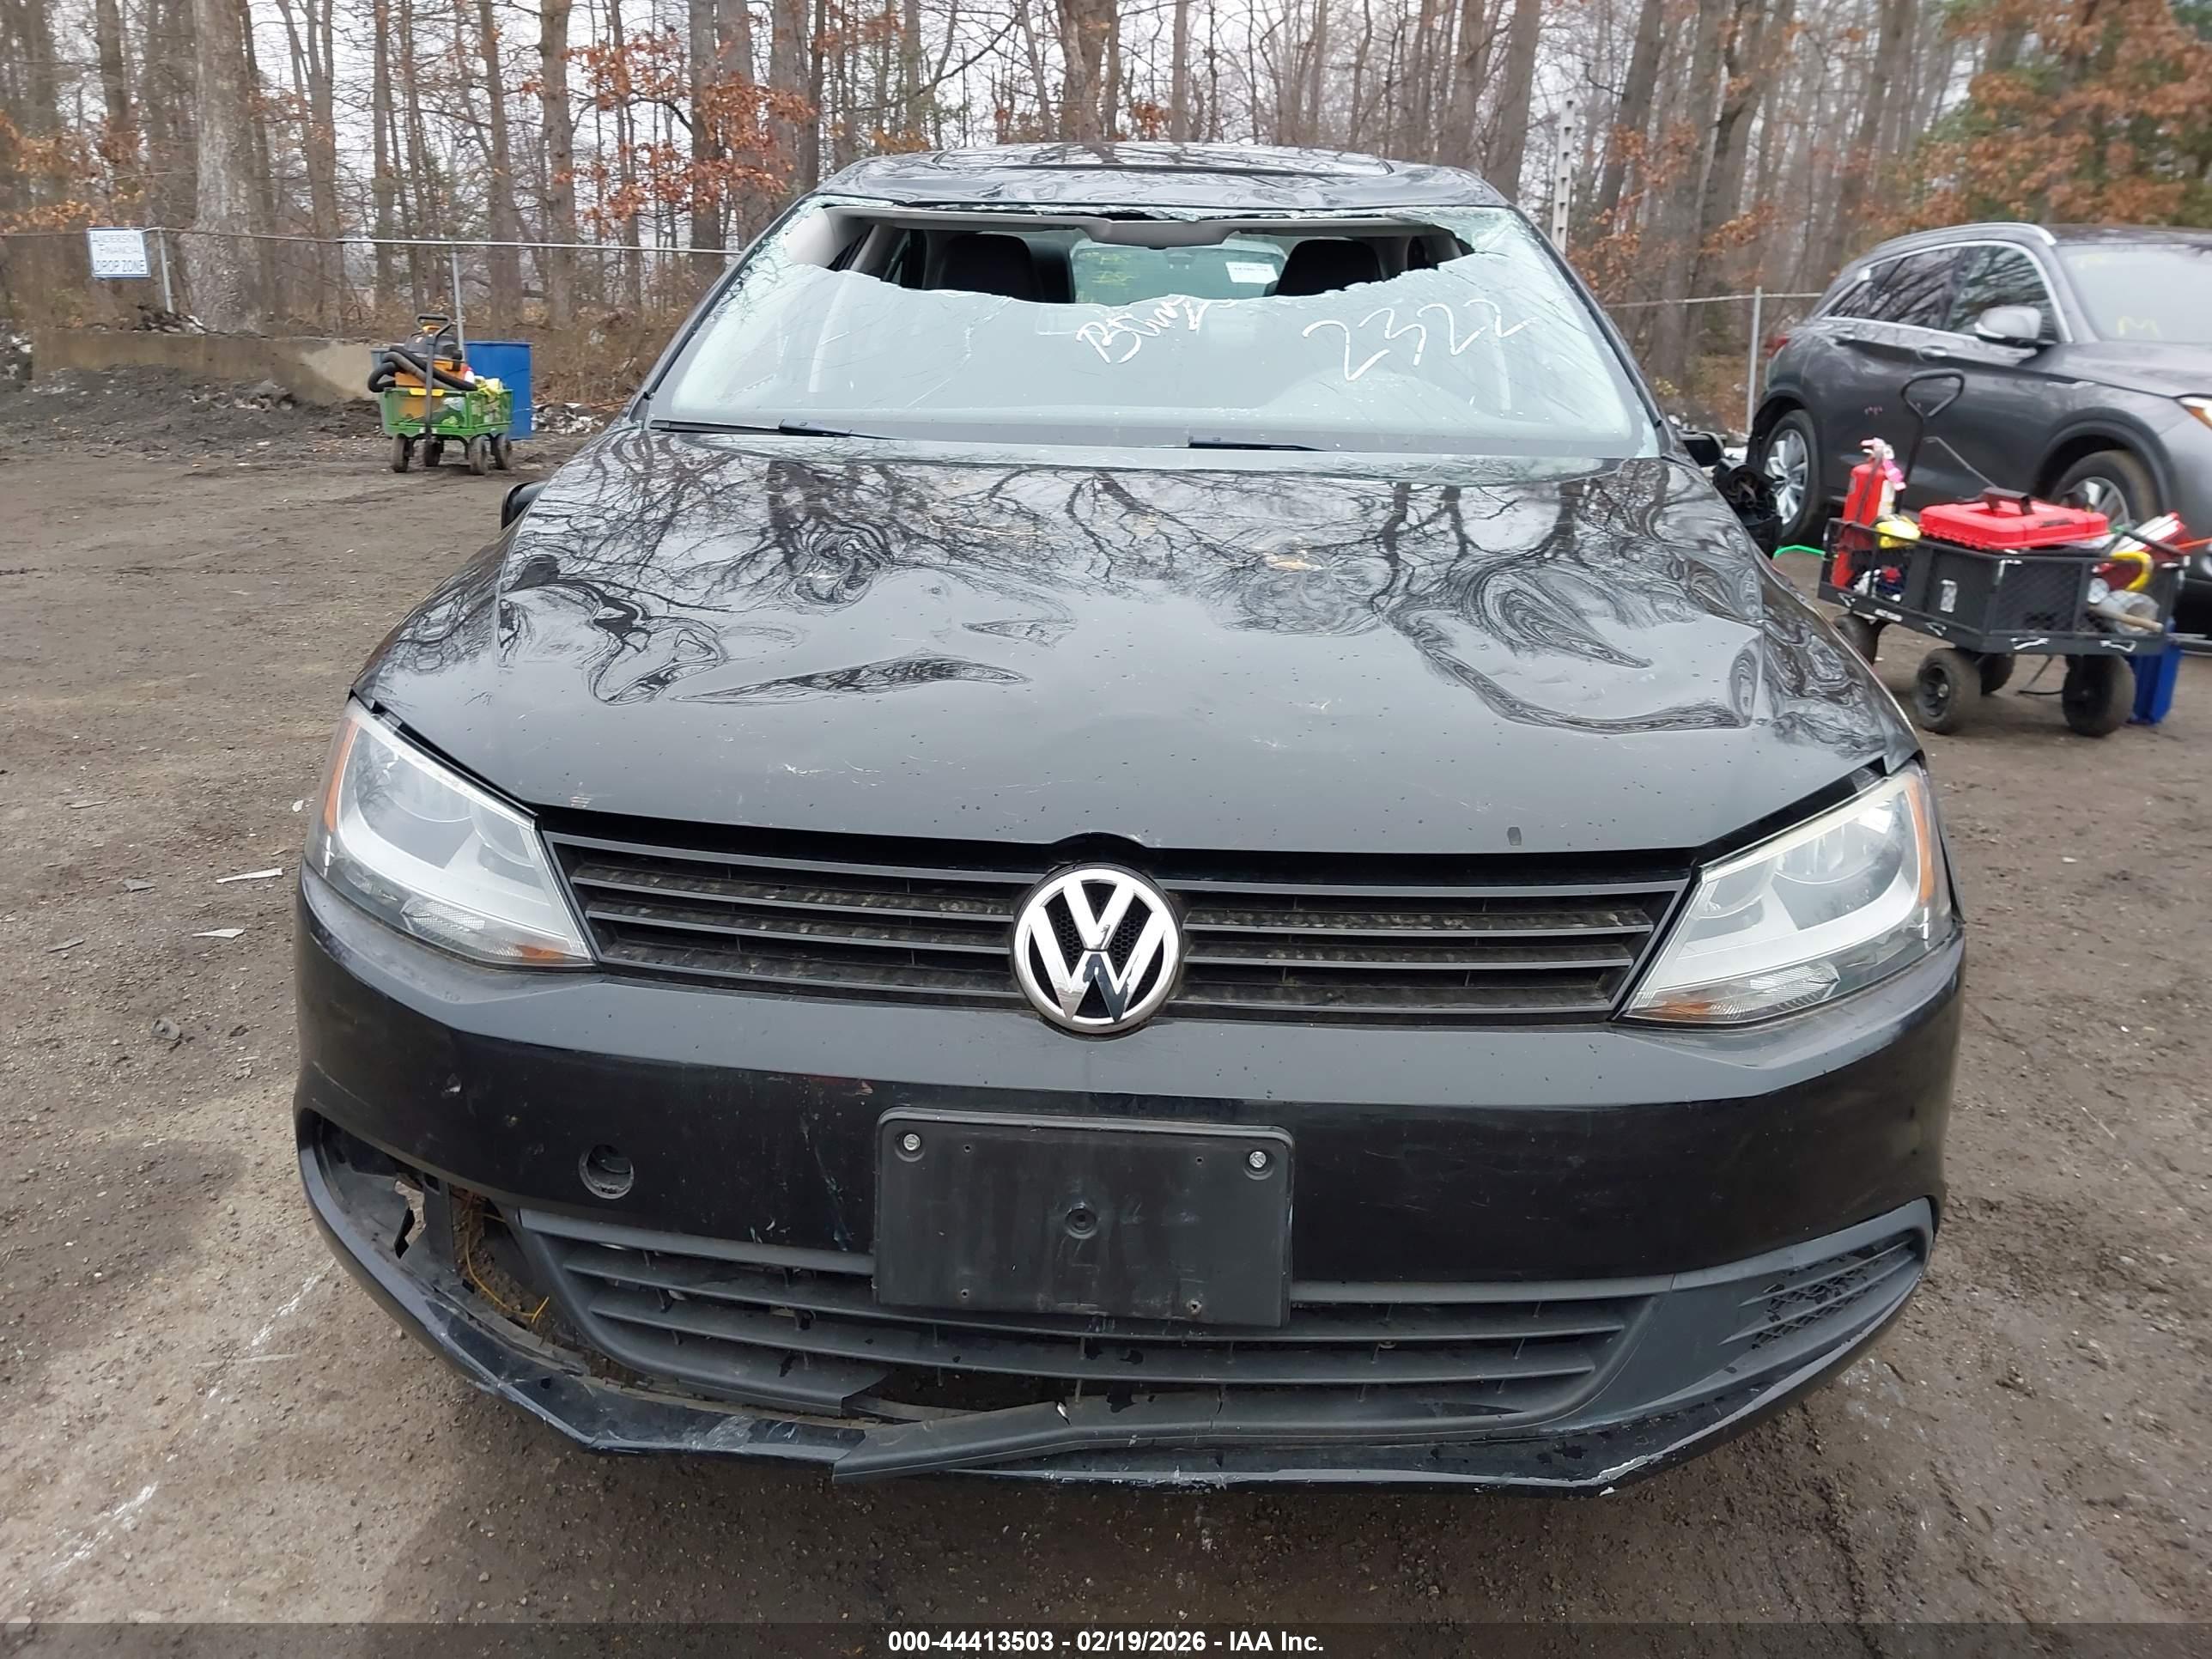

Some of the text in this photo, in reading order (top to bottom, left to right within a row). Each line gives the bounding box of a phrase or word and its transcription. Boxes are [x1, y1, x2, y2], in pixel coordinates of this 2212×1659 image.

[94, 259, 145, 272] DROP ZONE
[1020, 869, 1175, 1030] VW
